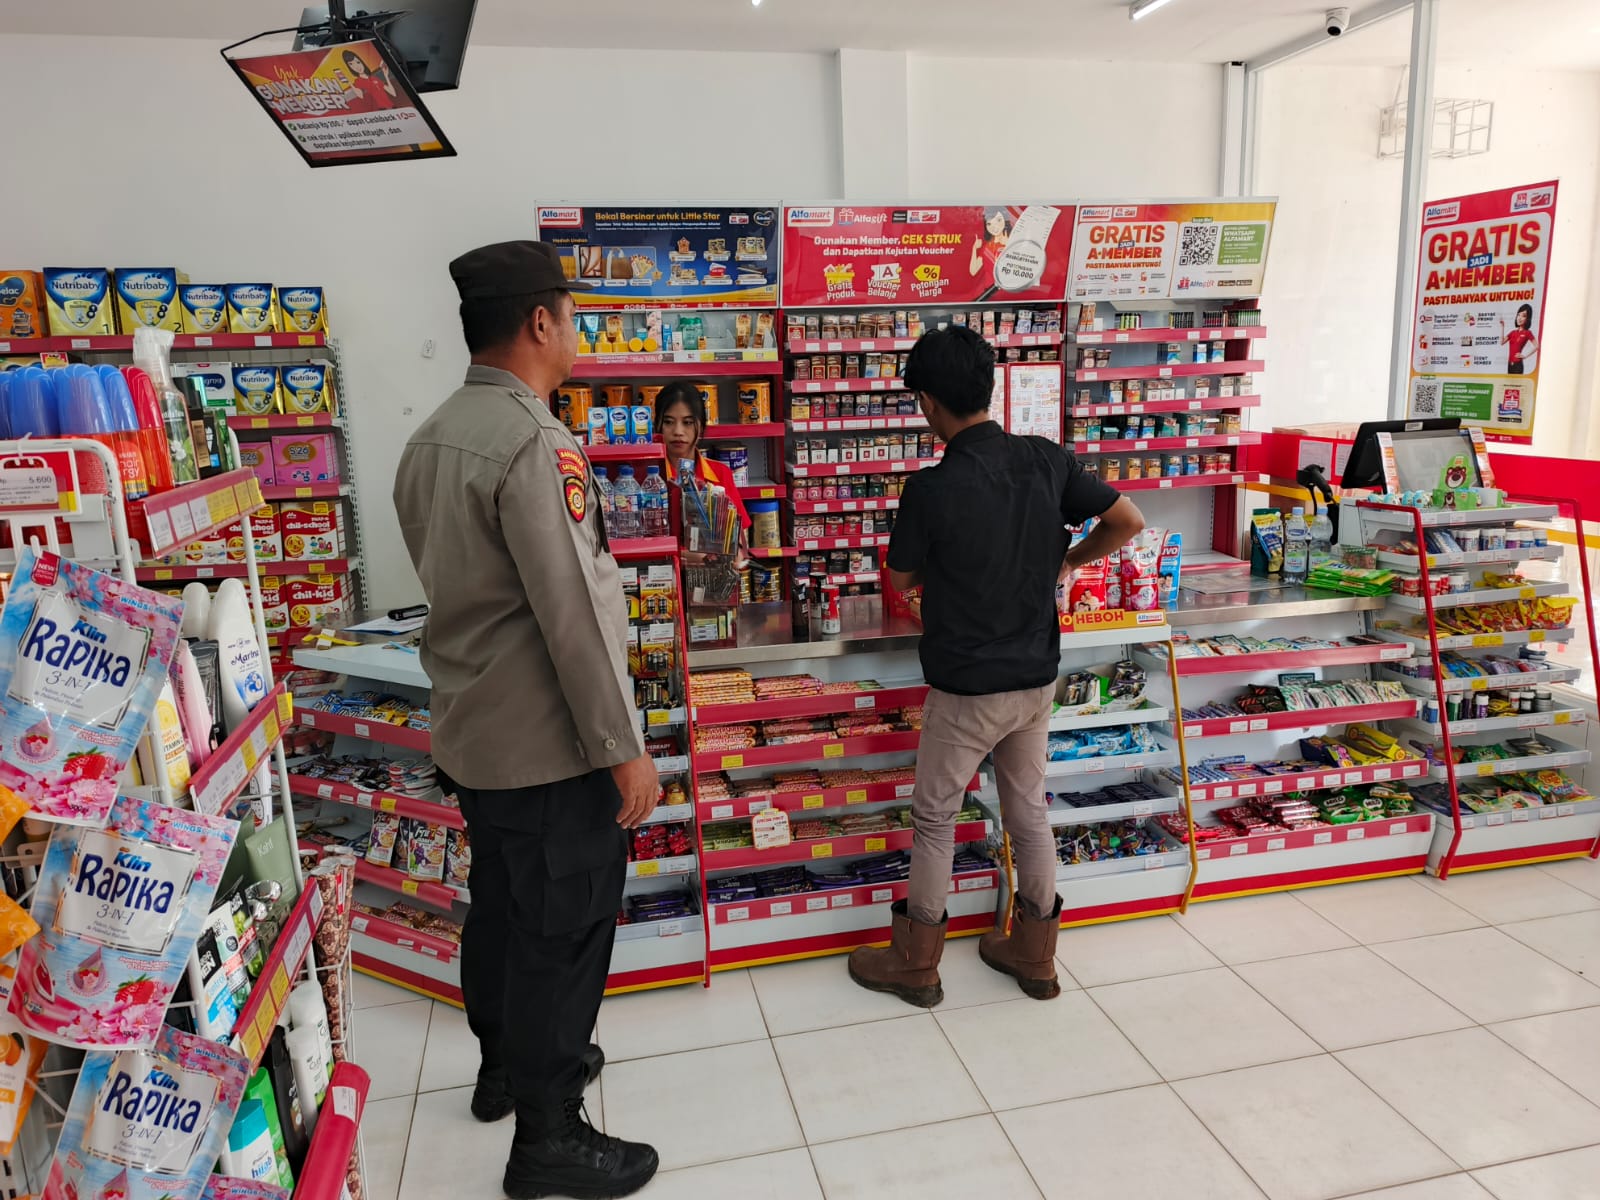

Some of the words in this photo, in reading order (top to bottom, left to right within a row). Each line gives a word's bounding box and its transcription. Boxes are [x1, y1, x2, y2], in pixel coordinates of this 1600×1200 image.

[256, 77, 342, 100] GUNAKAN
[274, 95, 350, 116] MEMBER
[542, 210, 577, 218] Alfamart
[595, 212, 619, 220] Bekal
[620, 212, 655, 220] Bersinar
[656, 212, 680, 220] untuk
[681, 212, 702, 220] Little
[703, 212, 720, 220] Star
[791, 210, 831, 219] Alfamart
[1427, 205, 1457, 216] Alfamart
[854, 212, 888, 224] Alfagift
[814, 236, 857, 246] Gunakan
[859, 235, 900, 246] Member,
[902, 235, 922, 244] CEK
[925, 234, 962, 244] STRUK
[1089, 225, 1165, 244] GRATIS
[1428, 221, 1541, 264] GRATIS
[823, 247, 840, 256] dan
[842, 247, 882, 257] Dapatkan
[885, 247, 919, 257] Kejutan
[919, 246, 954, 255] Voucher
[1469, 255, 1489, 267] JADI
[52, 281, 101, 291] Nutribaby
[123, 281, 170, 291] Nutribaby
[827, 281, 853, 292] Gratis
[867, 279, 901, 291] Voucher
[911, 279, 949, 291] Potongan
[185, 293, 221, 301] Nutribaby
[232, 292, 268, 301] Nutribaby
[827, 289, 855, 300] Produk
[867, 288, 897, 299] Belanja
[919, 287, 942, 298] Harga
[1423, 295, 1449, 306] PASTI
[1450, 293, 1487, 305] BANYAK
[1489, 288, 1535, 302] UNTUNG!
[288, 295, 315, 303] Nutrilon
[174, 322, 182, 332] 2
[241, 375, 270, 384] Nutrilon
[290, 374, 319, 382] Nutrilon
[286, 521, 330, 530] chil-school
[38, 563, 55, 572] NEW
[292, 590, 334, 600] chil-kid
[1076, 610, 1124, 625] HEBOH
[71, 619, 107, 645] Klin
[646, 743, 671, 751] VEREADY
[114, 852, 152, 872] Klin
[96, 903, 135, 926] 3-IN-1
[143, 1068, 180, 1090] Klin
[122, 1124, 163, 1144] 3-IN-1
